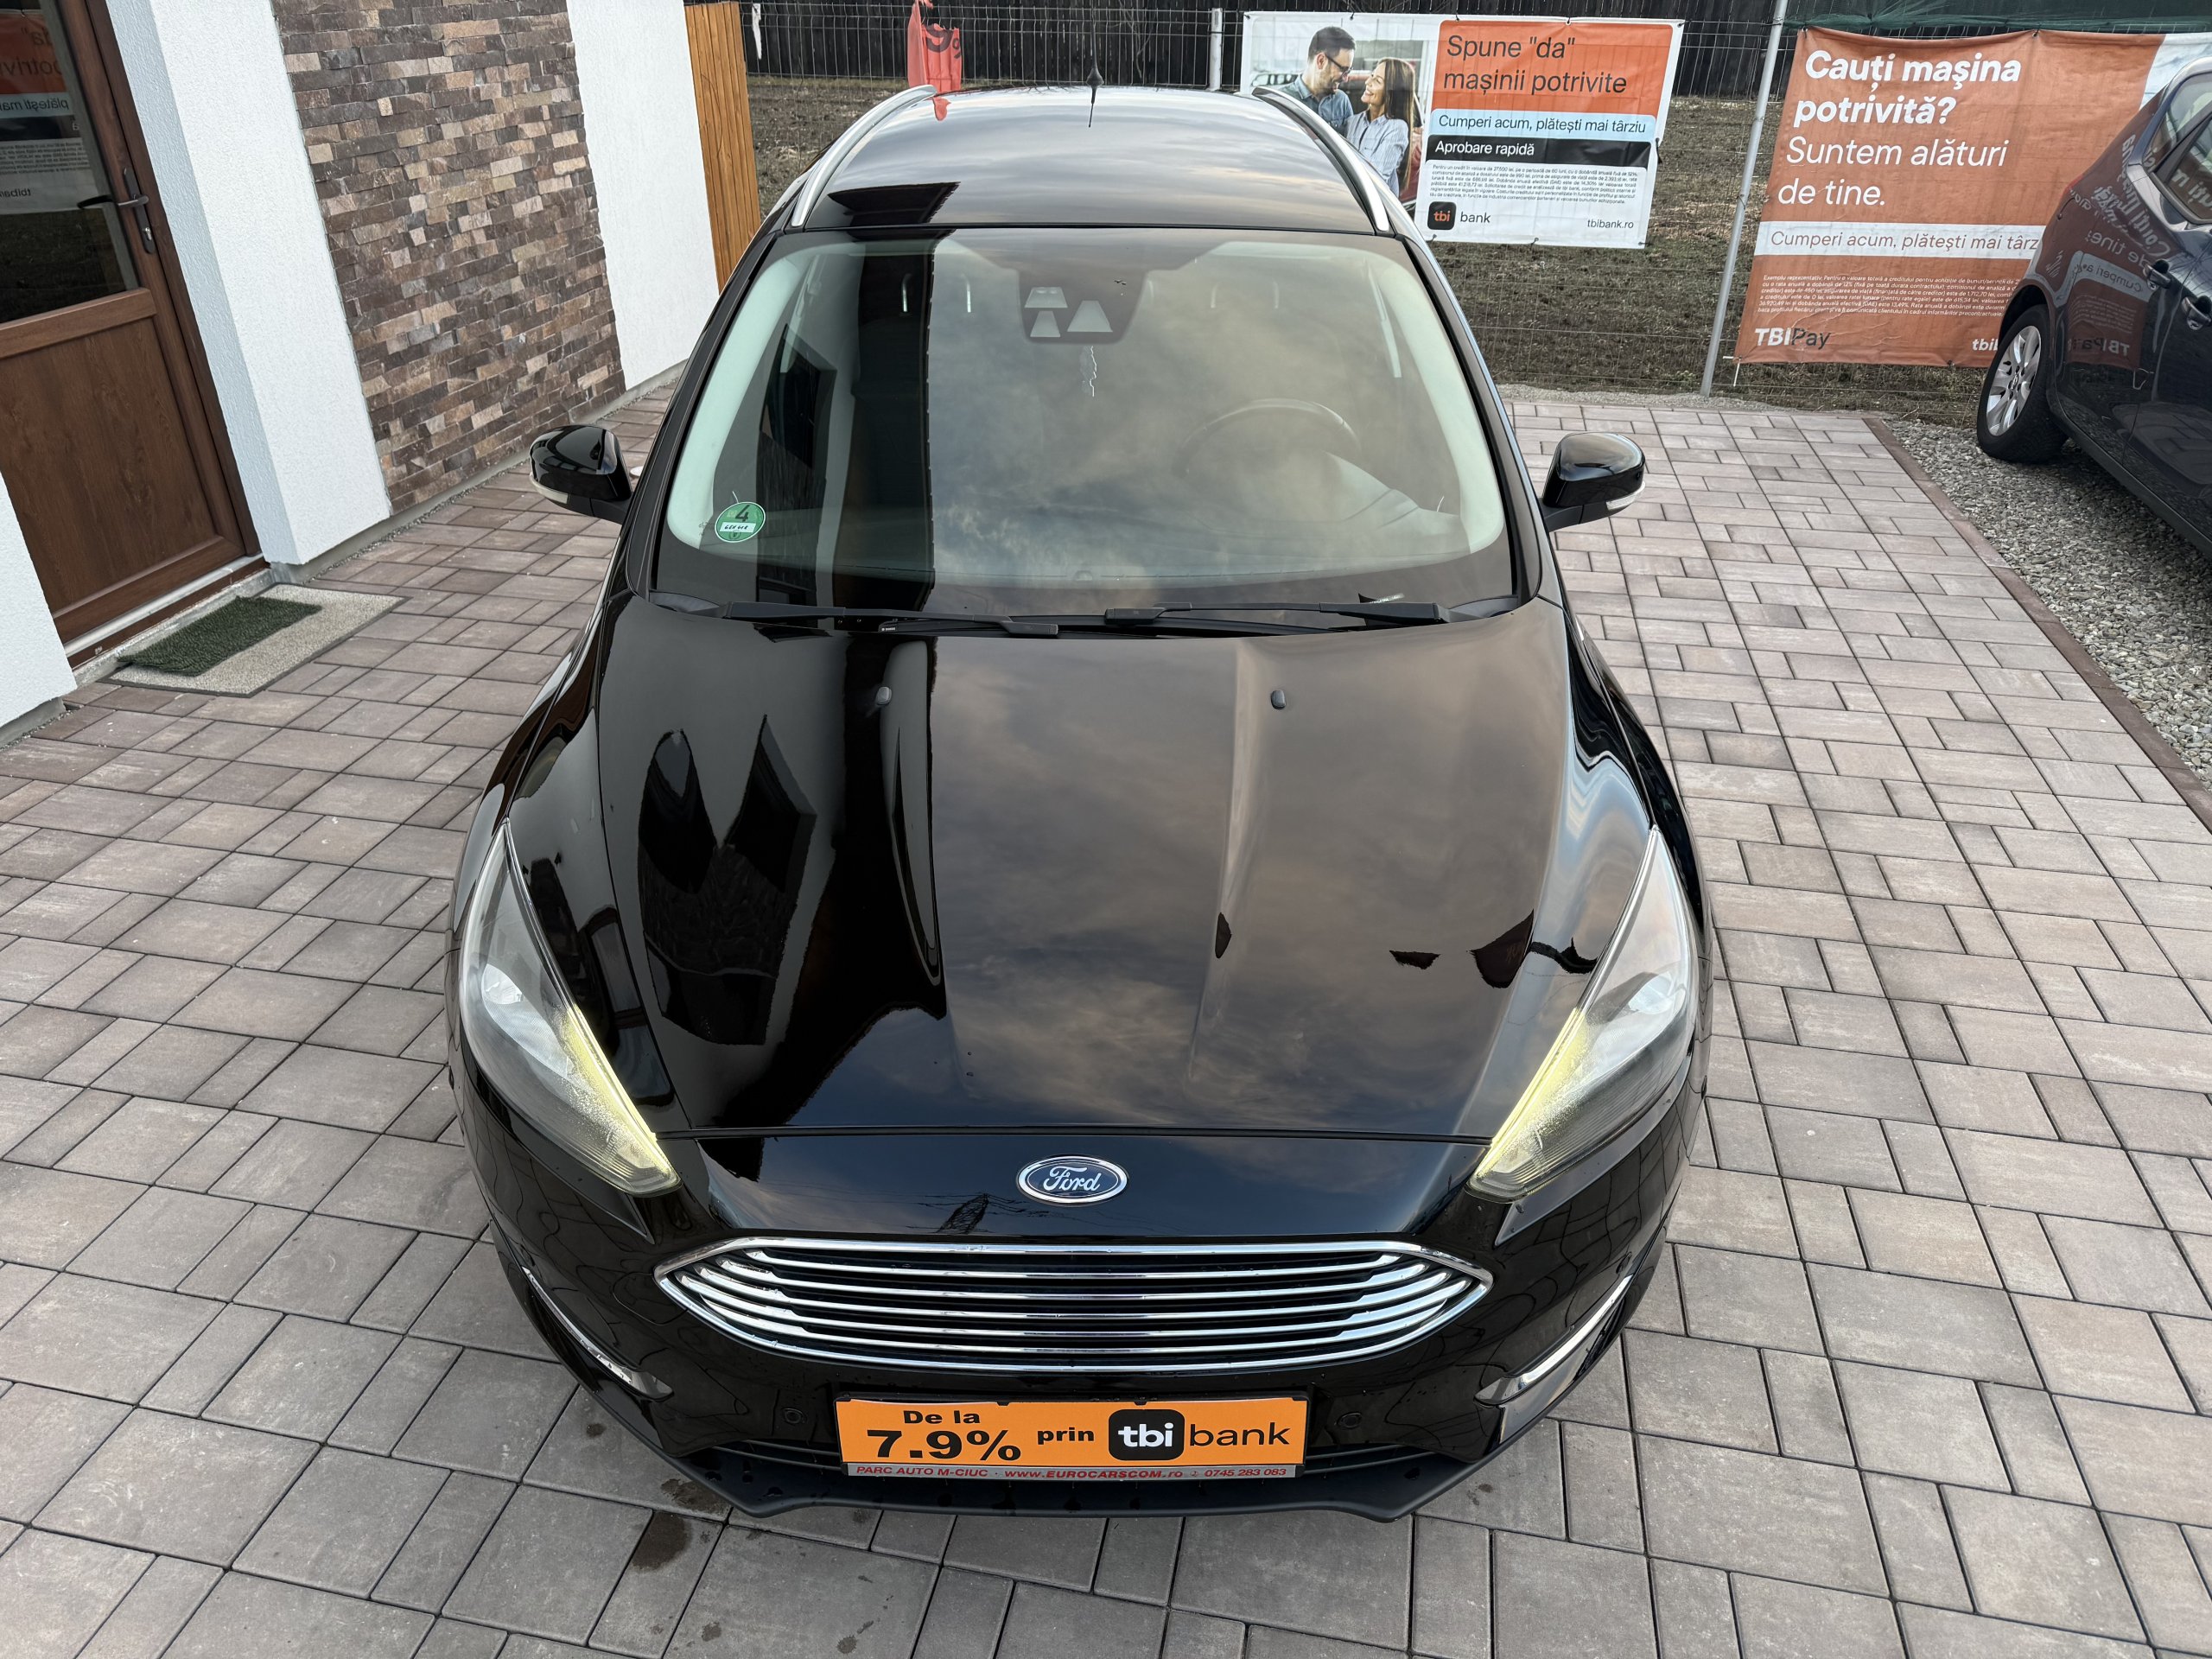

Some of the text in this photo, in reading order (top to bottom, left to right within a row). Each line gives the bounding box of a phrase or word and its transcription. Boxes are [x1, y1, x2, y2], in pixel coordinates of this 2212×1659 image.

[1446, 35, 1576, 60] Spune "da"
[1443, 69, 1627, 95] mașinii potrivite
[1806, 50, 1895, 92] Cauți
[1439, 115, 1645, 133] Cumperi acum, plătești mai târziu
[1793, 95, 1956, 128] potrivită?
[1434, 141, 1535, 156] Aprobare rapidă
[1786, 136, 2010, 167] Suntem alături
[1777, 178, 1885, 206] de tine.
[1433, 211, 1634, 230] tbi bank tbibank.ro
[1770, 232, 1842, 249] Cumperi
[1847, 234, 1896, 250] acum,
[1970, 236, 2001, 249] mai
[2005, 236, 2038, 251] târz
[734, 504, 750, 523] 4
[1043, 1166, 1102, 1192] Ford
[903, 1409, 981, 1425] De la
[867, 1429, 1021, 1461] 7.9%
[1037, 1427, 1095, 1446] prin
[1118, 1421, 1291, 1448] tbi bank
[856, 1465, 893, 1475] PARC
[896, 1467, 934, 1476] AUTO
[937, 1468, 988, 1478] M-CIUC
[1204, 1469, 1235, 1478] 0745
[1237, 1468, 1261, 1477] 283
[1263, 1468, 1287, 1477] 083
